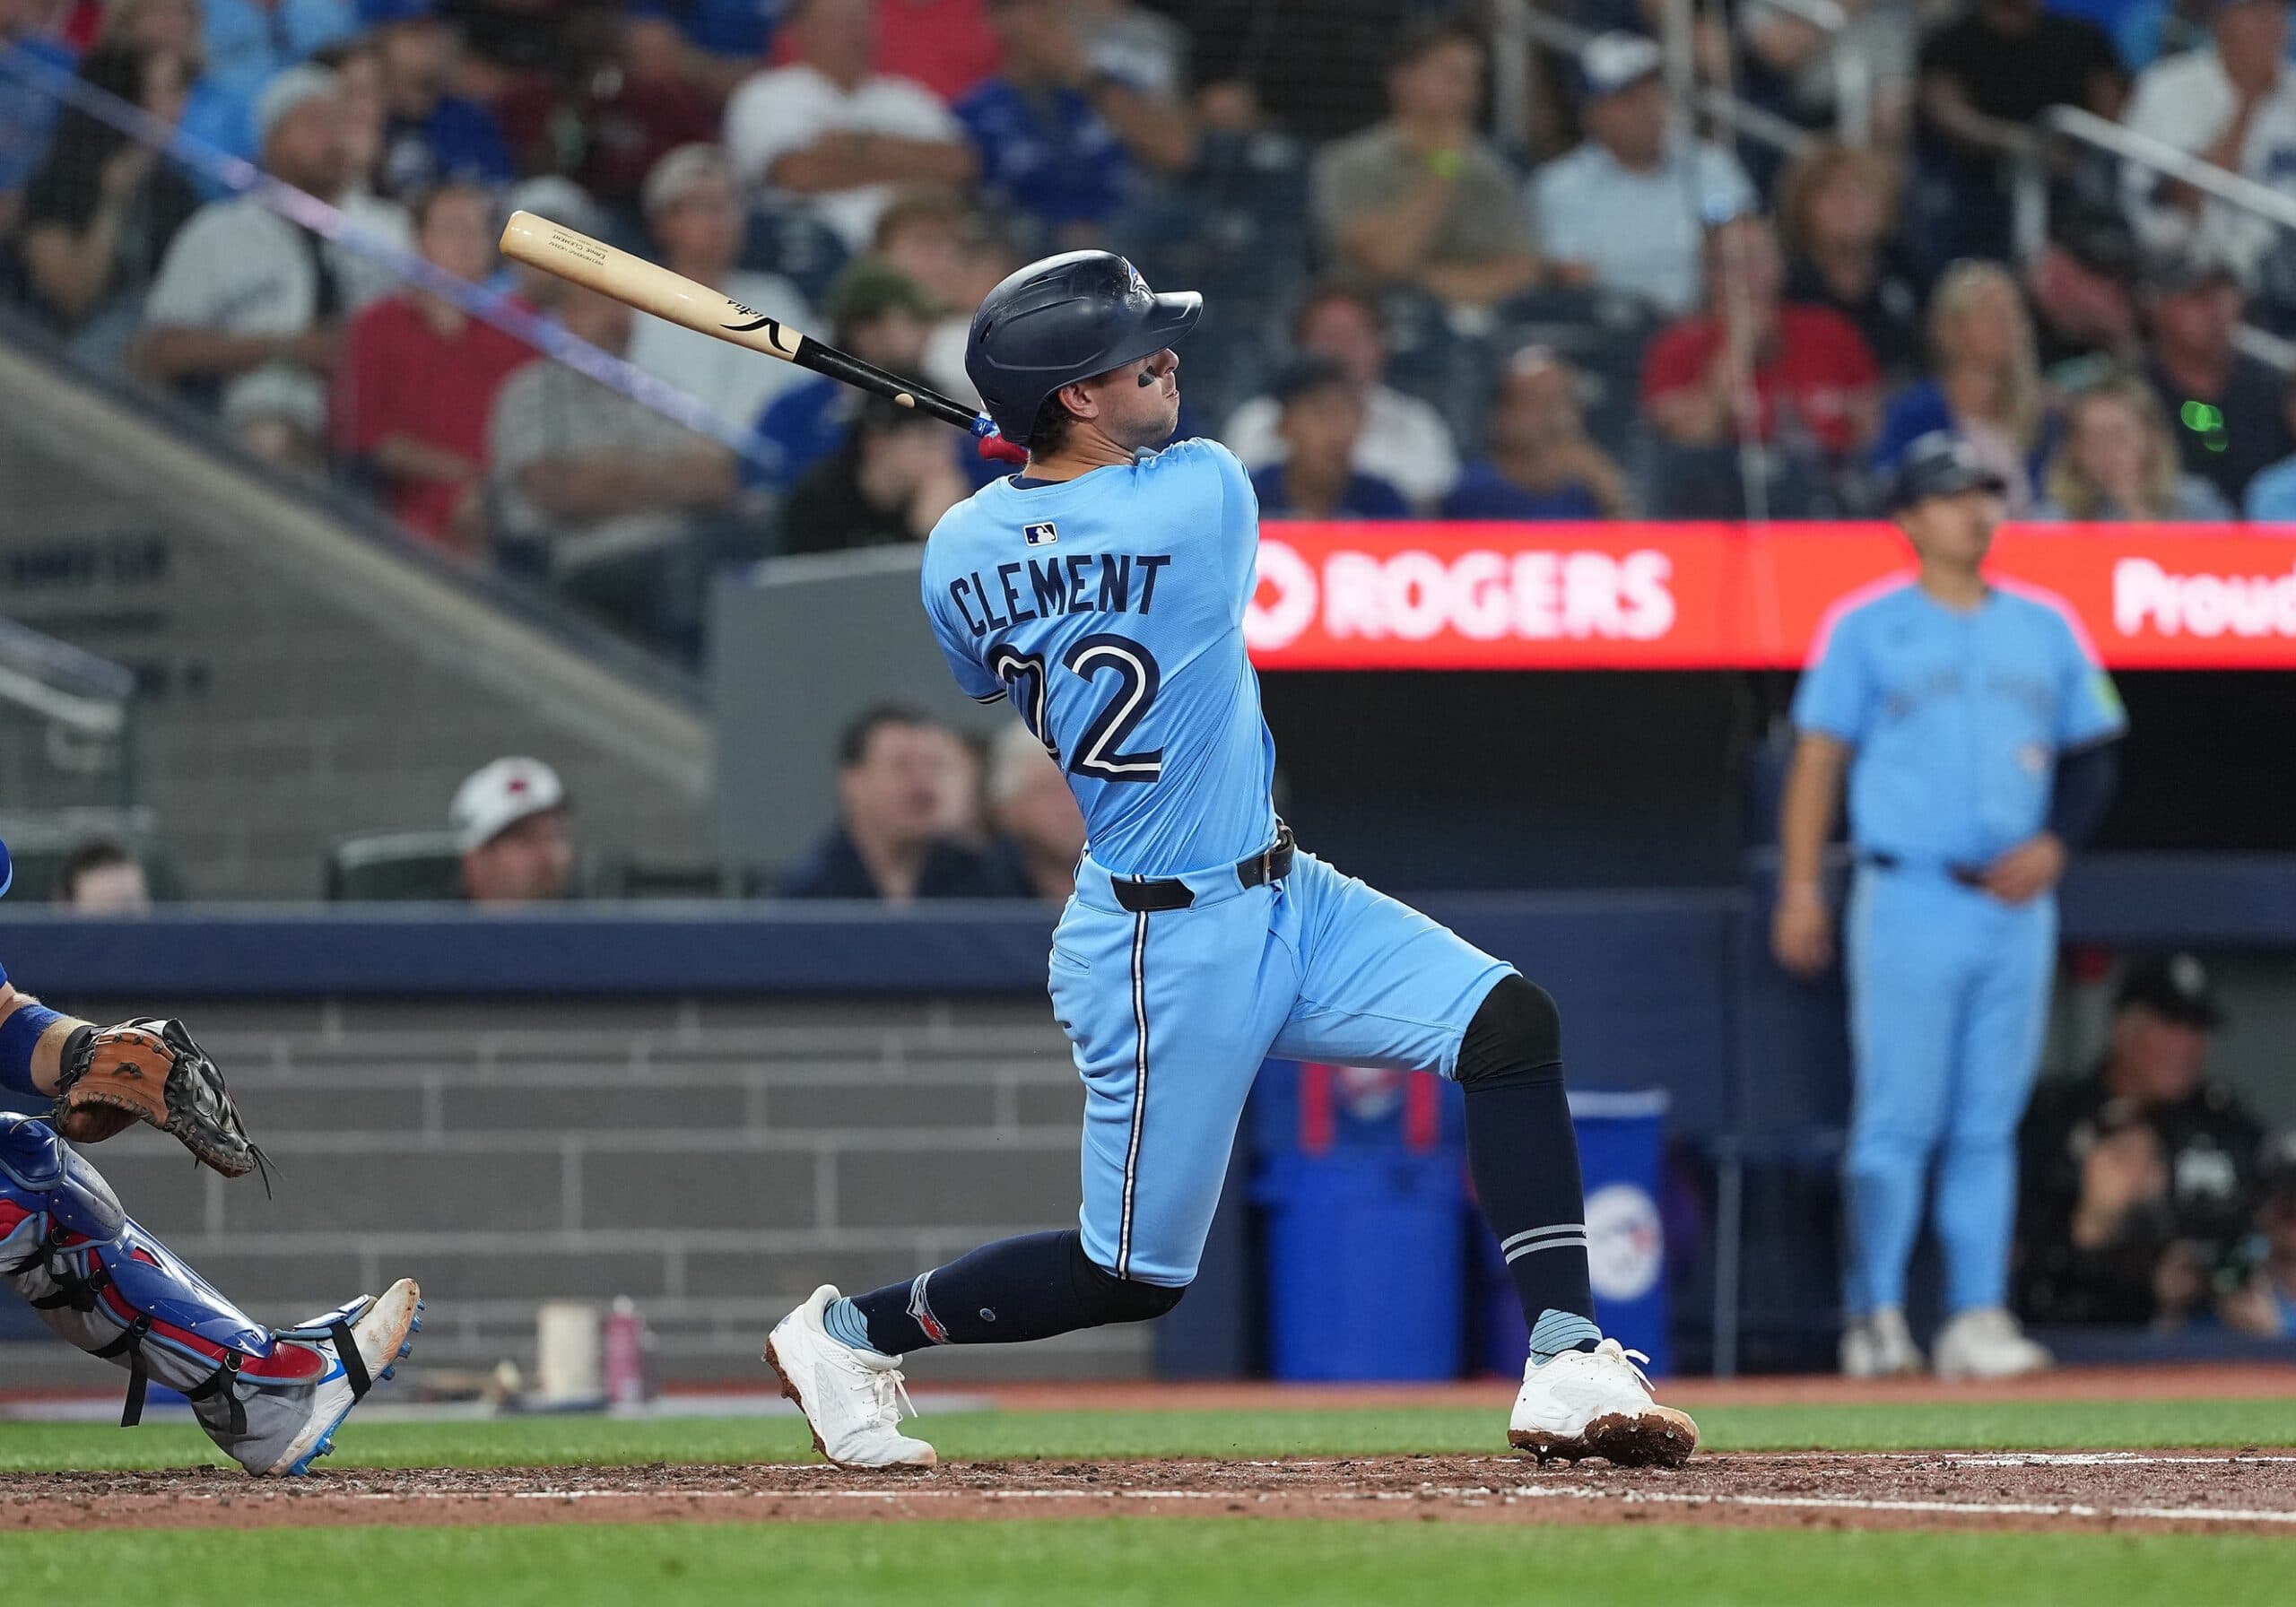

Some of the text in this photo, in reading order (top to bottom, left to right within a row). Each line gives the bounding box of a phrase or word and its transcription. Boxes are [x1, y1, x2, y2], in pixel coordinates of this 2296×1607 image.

[552, 234, 584, 251] CLEMENT
[949, 553, 1171, 638] CLEMENT
[1324, 550, 1676, 641] ROGERS
[987, 632, 1164, 783] 22
